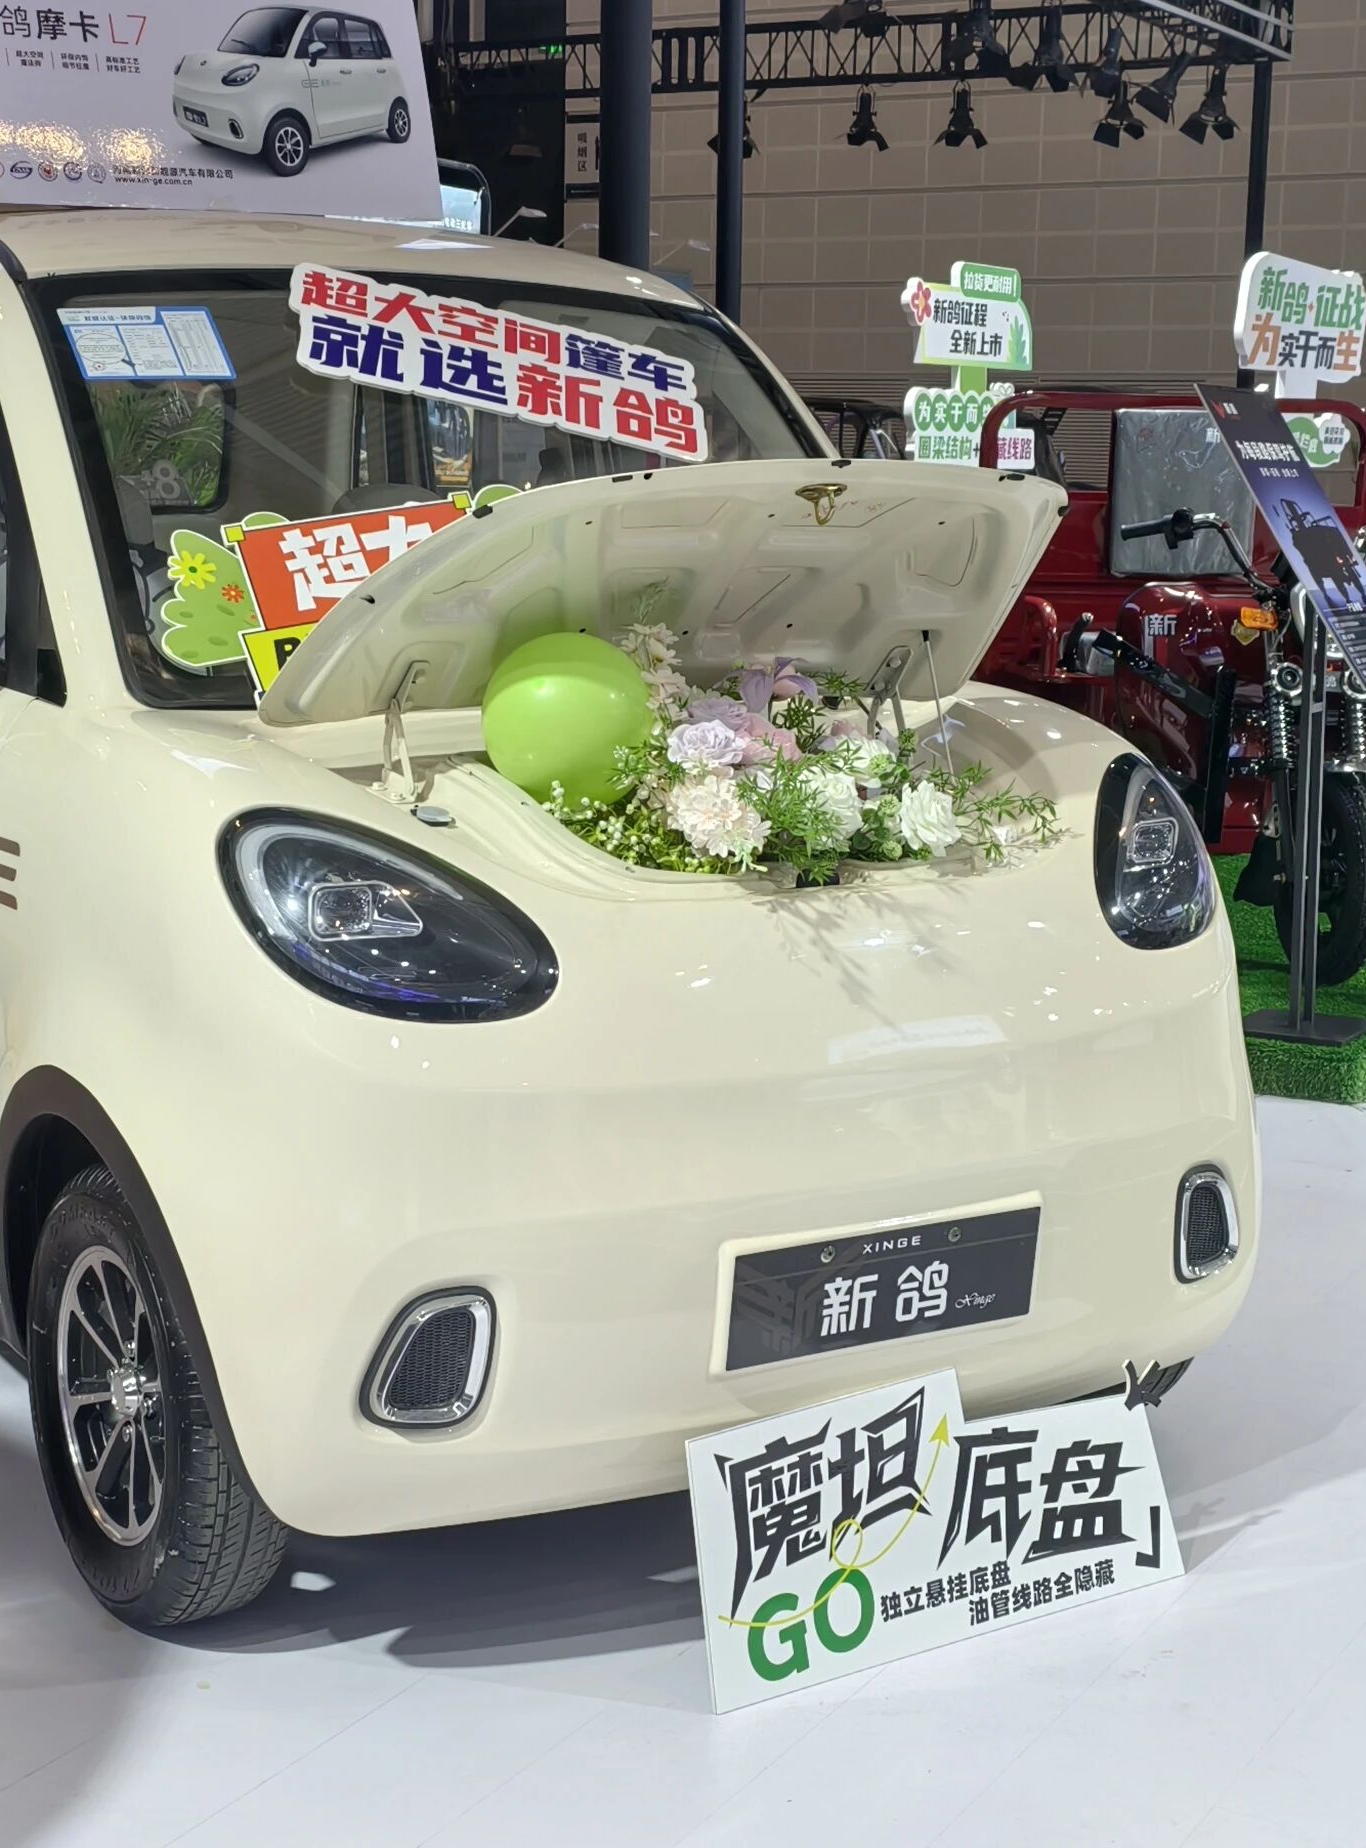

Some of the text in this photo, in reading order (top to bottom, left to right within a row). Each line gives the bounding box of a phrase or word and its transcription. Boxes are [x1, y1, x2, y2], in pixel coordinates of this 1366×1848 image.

[301, 271, 688, 393] 超大空间篷车
[933, 299, 988, 327] 新鸽征程
[950, 329, 1003, 357] 全新上市
[1247, 312, 1360, 371] 为实干而生
[309, 314, 698, 454] 就选新鸽
[862, 1235, 922, 1255] XINGE
[820, 1260, 949, 1337] 新鸽
[954, 1292, 996, 1310] Xinge
[880, 1560, 1013, 1623] 独立悬挂底盘
[968, 1558, 1117, 1627] 油管线路全隐藏
[747, 1567, 876, 1682] GO
